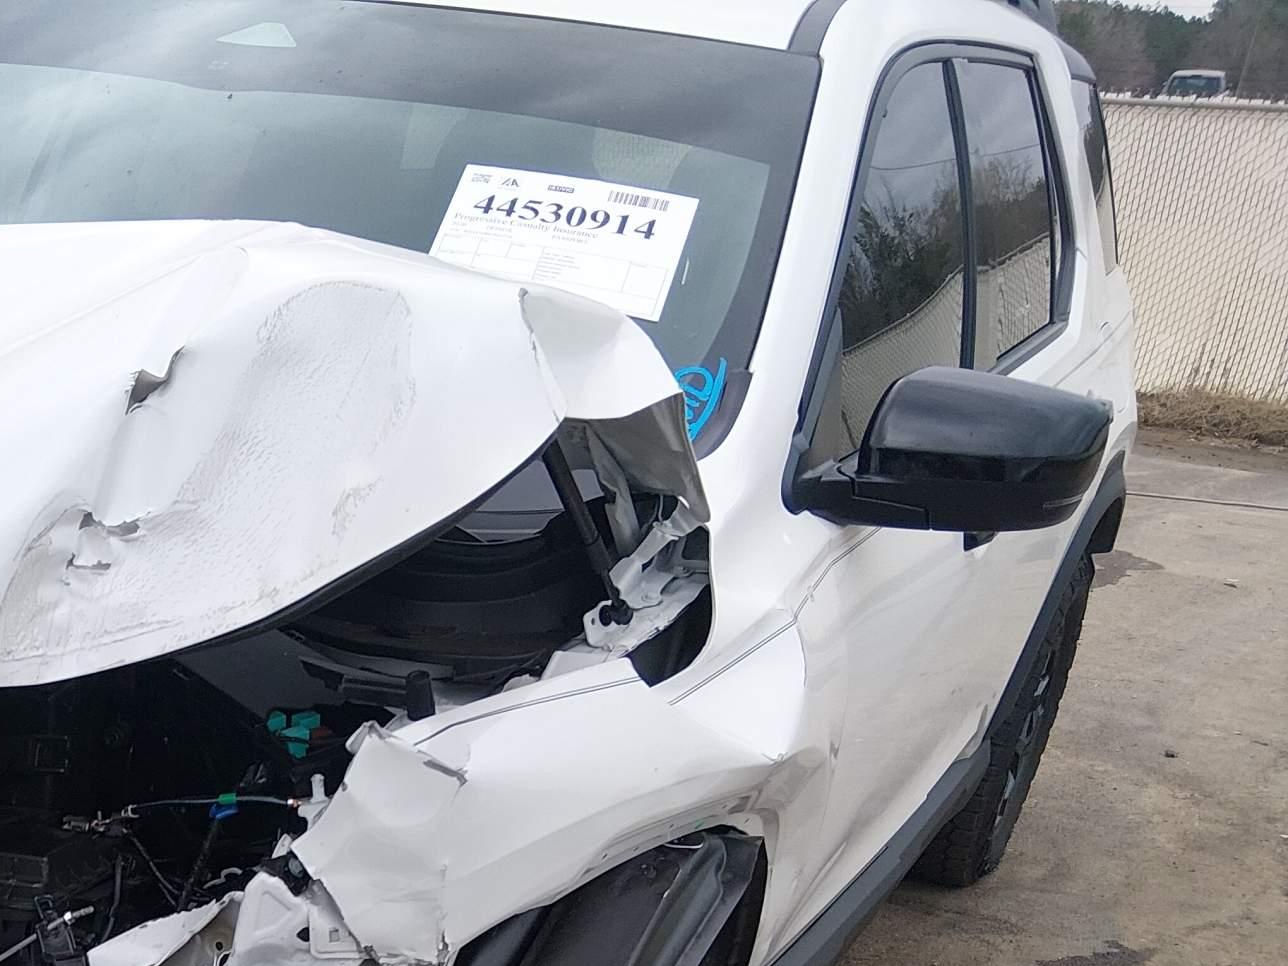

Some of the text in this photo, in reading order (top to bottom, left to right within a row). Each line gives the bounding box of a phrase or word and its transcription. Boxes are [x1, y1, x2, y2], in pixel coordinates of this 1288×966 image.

[454, 211, 510, 226] Progressive
[511, 219, 551, 232] Casualty
[552, 226, 599, 239] Insurance
[473, 193, 657, 241] 44530914
